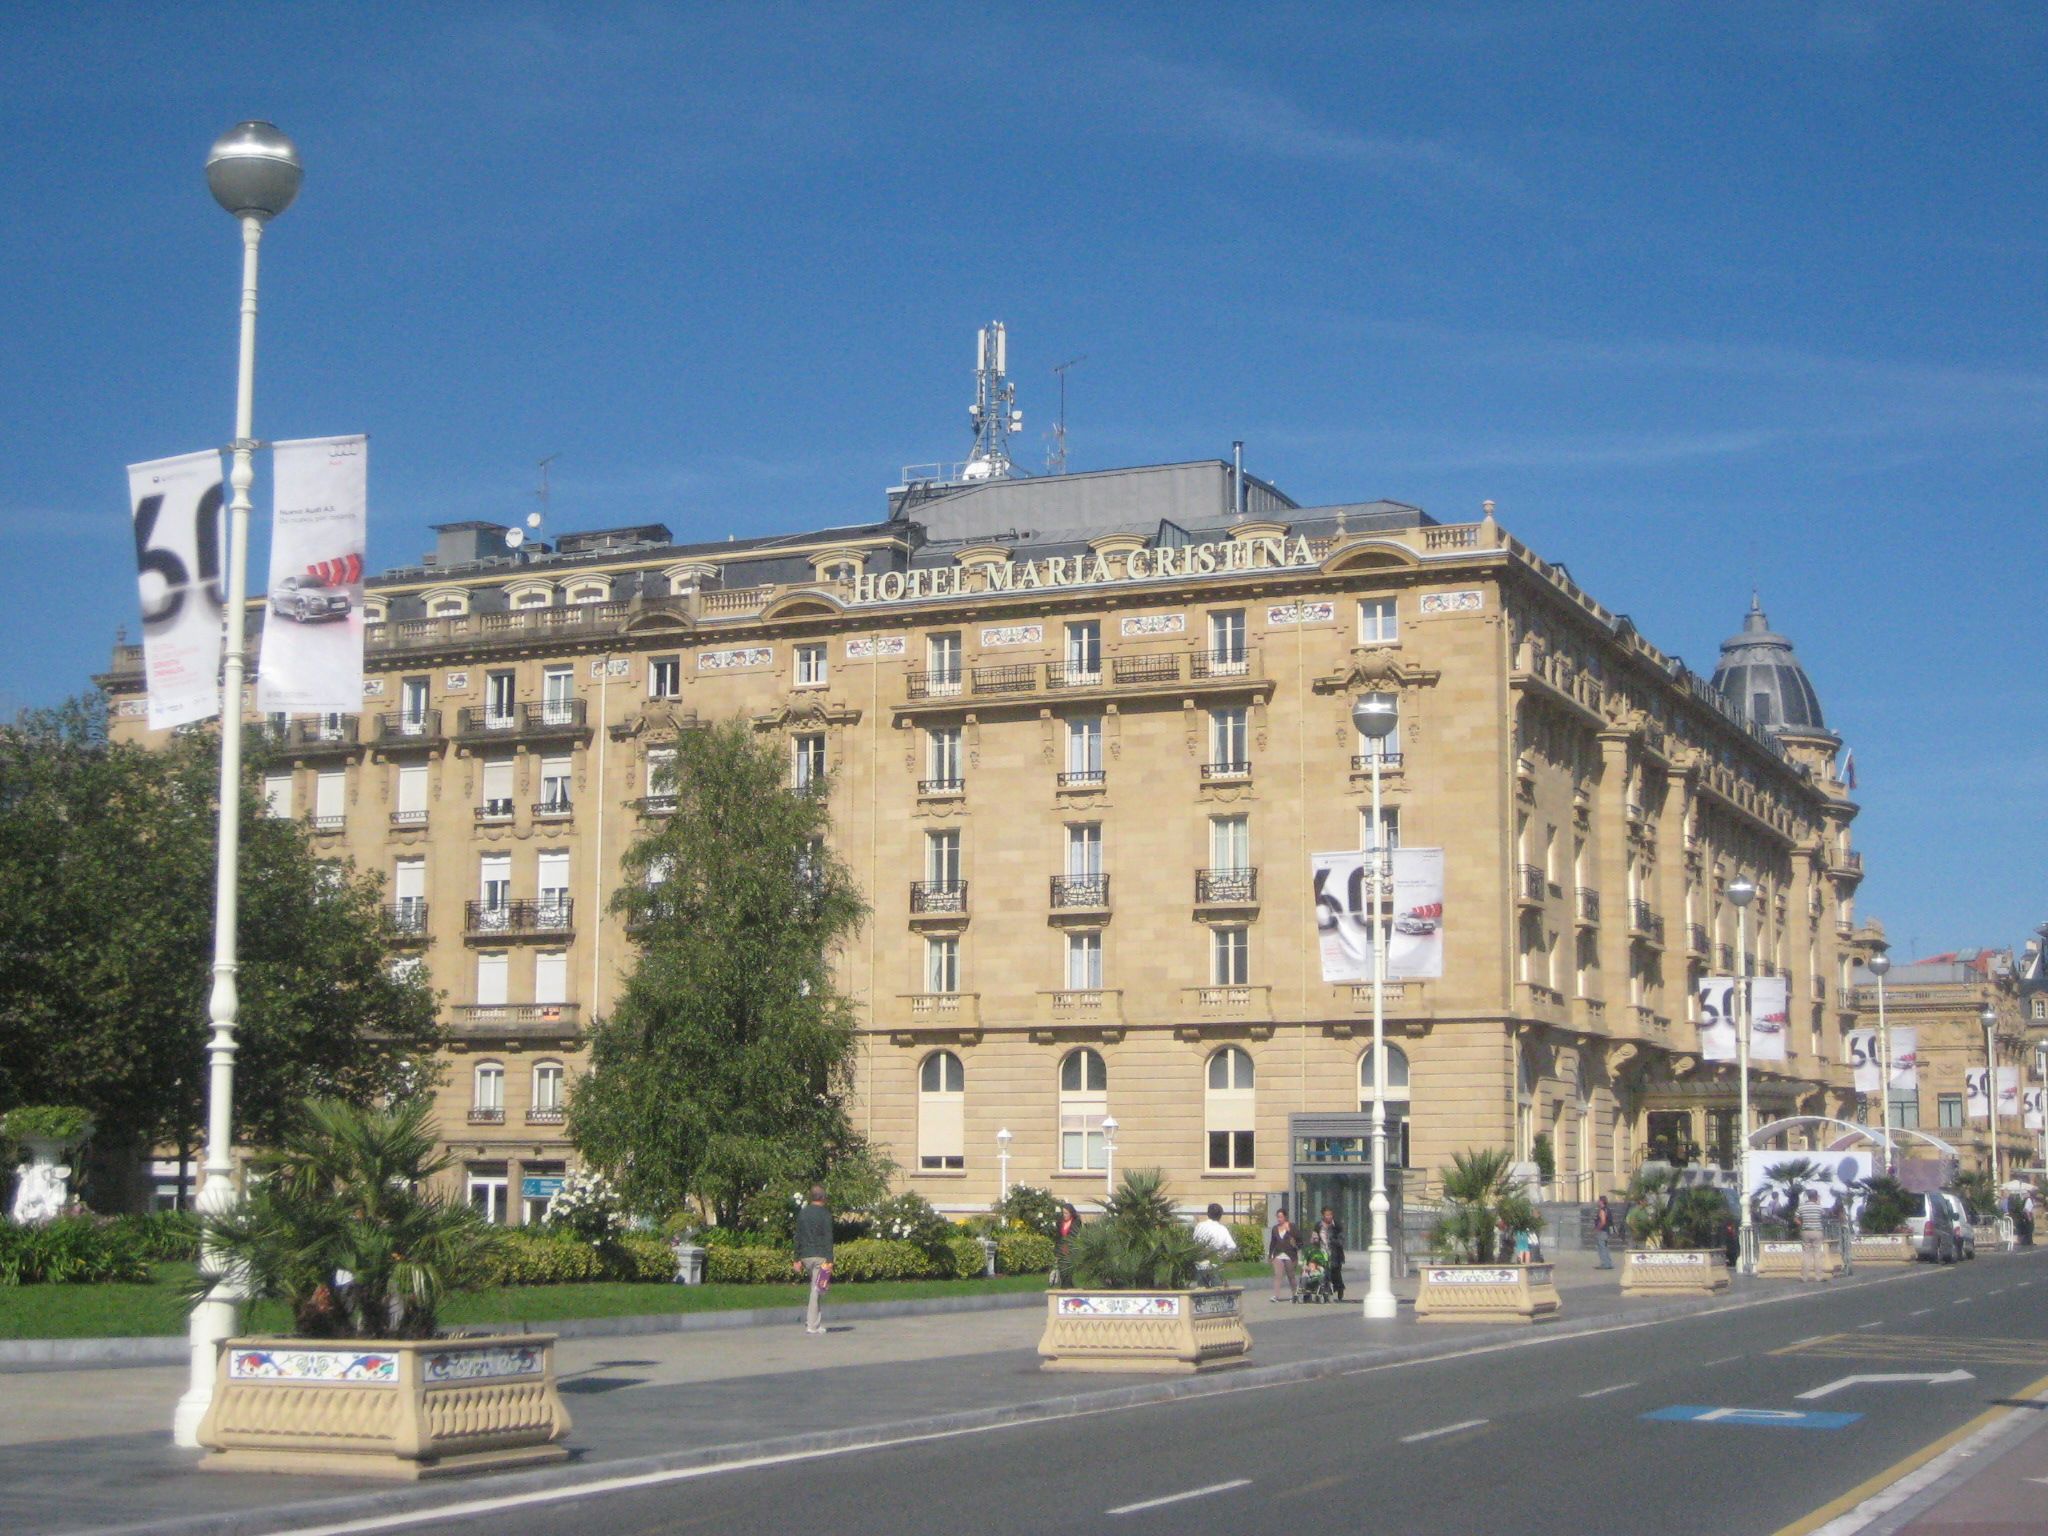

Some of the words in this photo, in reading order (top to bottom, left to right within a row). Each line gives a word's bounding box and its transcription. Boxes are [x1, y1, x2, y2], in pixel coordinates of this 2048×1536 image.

[852, 565, 973, 602] HOTEL
[984, 553, 1114, 593] MARIA
[1126, 533, 1316, 579] CRISTINA
